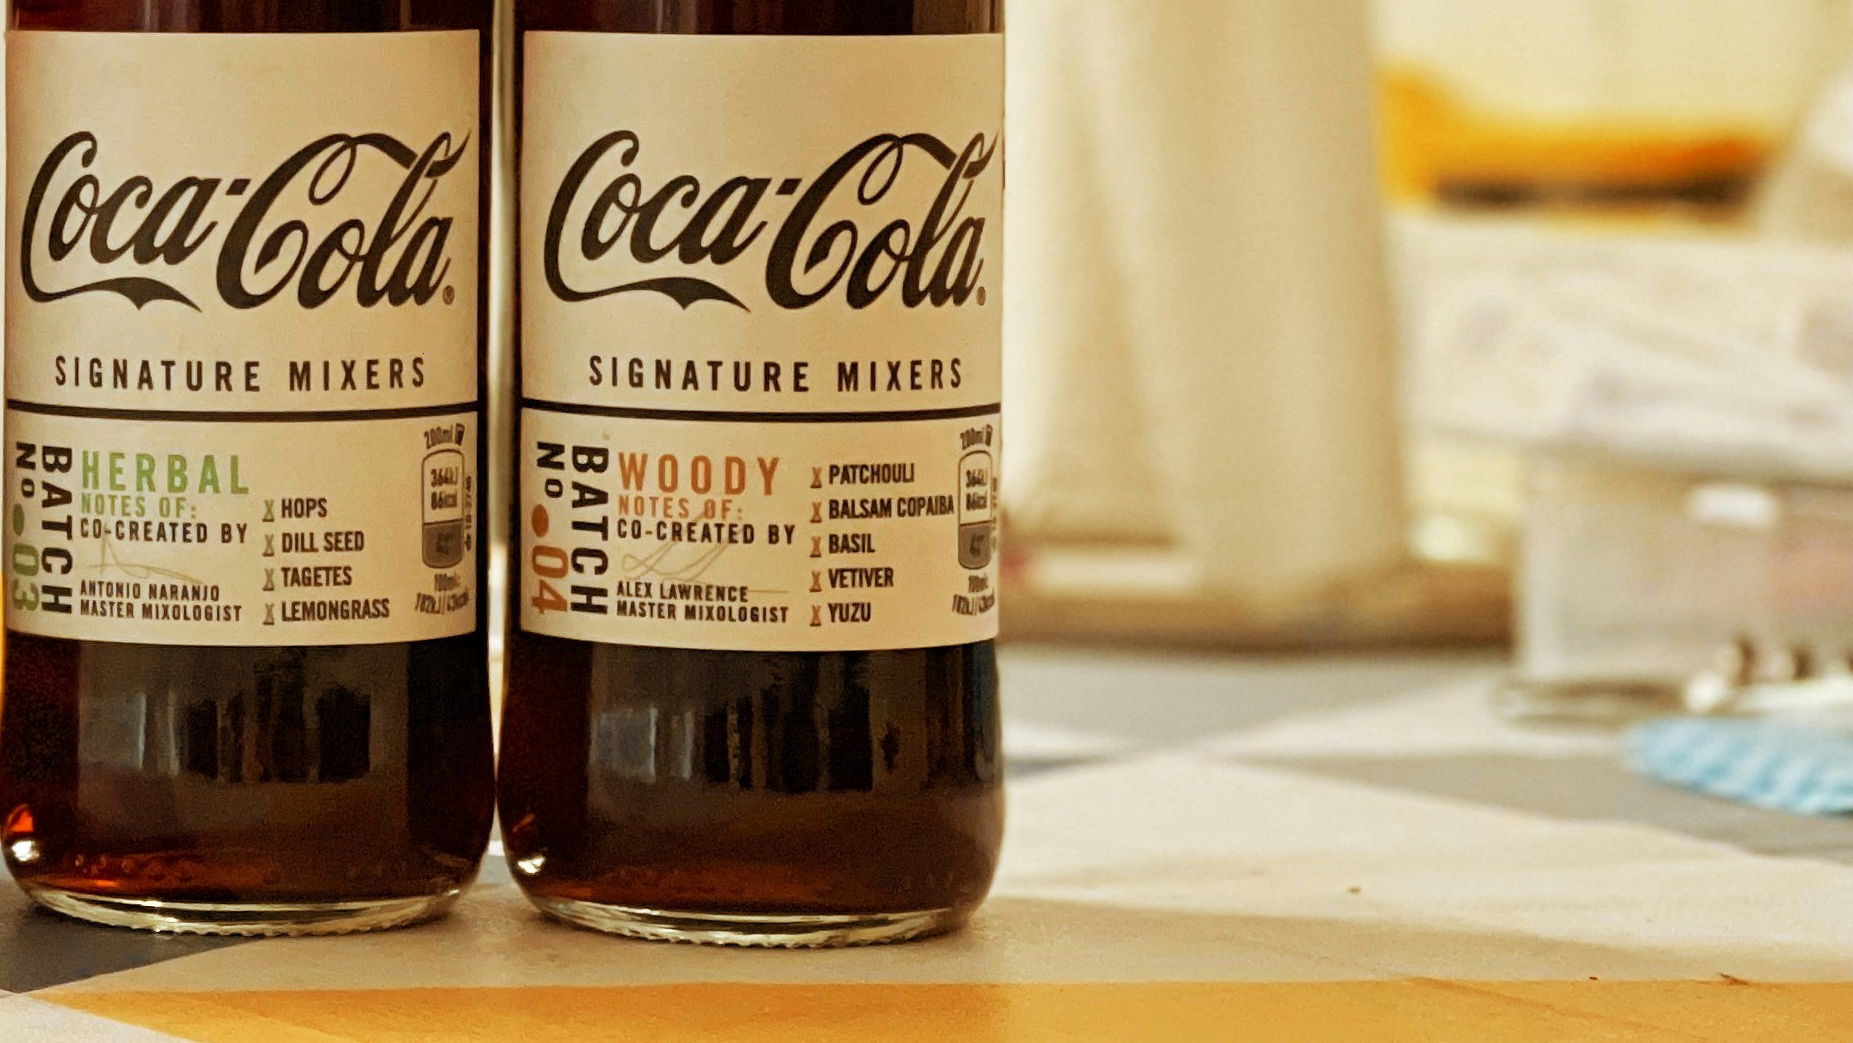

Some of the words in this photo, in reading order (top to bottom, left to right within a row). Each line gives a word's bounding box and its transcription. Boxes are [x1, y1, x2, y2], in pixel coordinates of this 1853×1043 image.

[20, 129, 470, 313] Coca-Cola
[547, 129, 999, 313] Coca-Cola
[55, 355, 260, 392] SIGNATURE
[289, 357, 425, 392] MIXERS
[589, 355, 809, 393] SIGNATURE
[838, 357, 962, 393] MIXERS
[81, 450, 249, 495] HERBAL
[617, 452, 781, 496] WOODY
[828, 462, 915, 485] PATCHOULI
[81, 494, 147, 517] NOTES
[158, 499, 197, 519] OF:
[281, 498, 328, 519] HOPS
[618, 496, 688, 518] NOTES
[704, 499, 743, 520] OF:
[828, 497, 893, 520] BALSAM
[897, 494, 955, 518] COPAIBA
[41, 445, 73, 615] BATCH
[80, 522, 208, 544] CO-CREATED
[220, 523, 248, 544] BY
[571, 445, 609, 615] BATCH
[617, 519, 755, 545] CO-CREATED
[768, 524, 795, 546] BY
[281, 533, 319, 554] DILL
[324, 531, 365, 553] SEED
[828, 534, 875, 554] BASIL
[11, 544, 39, 612] 03
[281, 566, 352, 588] TAGETES
[532, 544, 569, 615] 04
[828, 567, 894, 589] VETIVER
[80, 580, 142, 600] ANTONIO
[148, 583, 220, 602] NARANJO
[617, 581, 652, 599] ALEX
[660, 582, 748, 602] LAWRENCE
[80, 599, 135, 619] MASTER
[142, 604, 242, 622] MIXOLOGIST
[281, 598, 390, 622] LEMONGRASS
[617, 601, 676, 620] MASTER
[684, 604, 788, 624] MIXOLOGIST
[827, 601, 872, 624] YUZU
